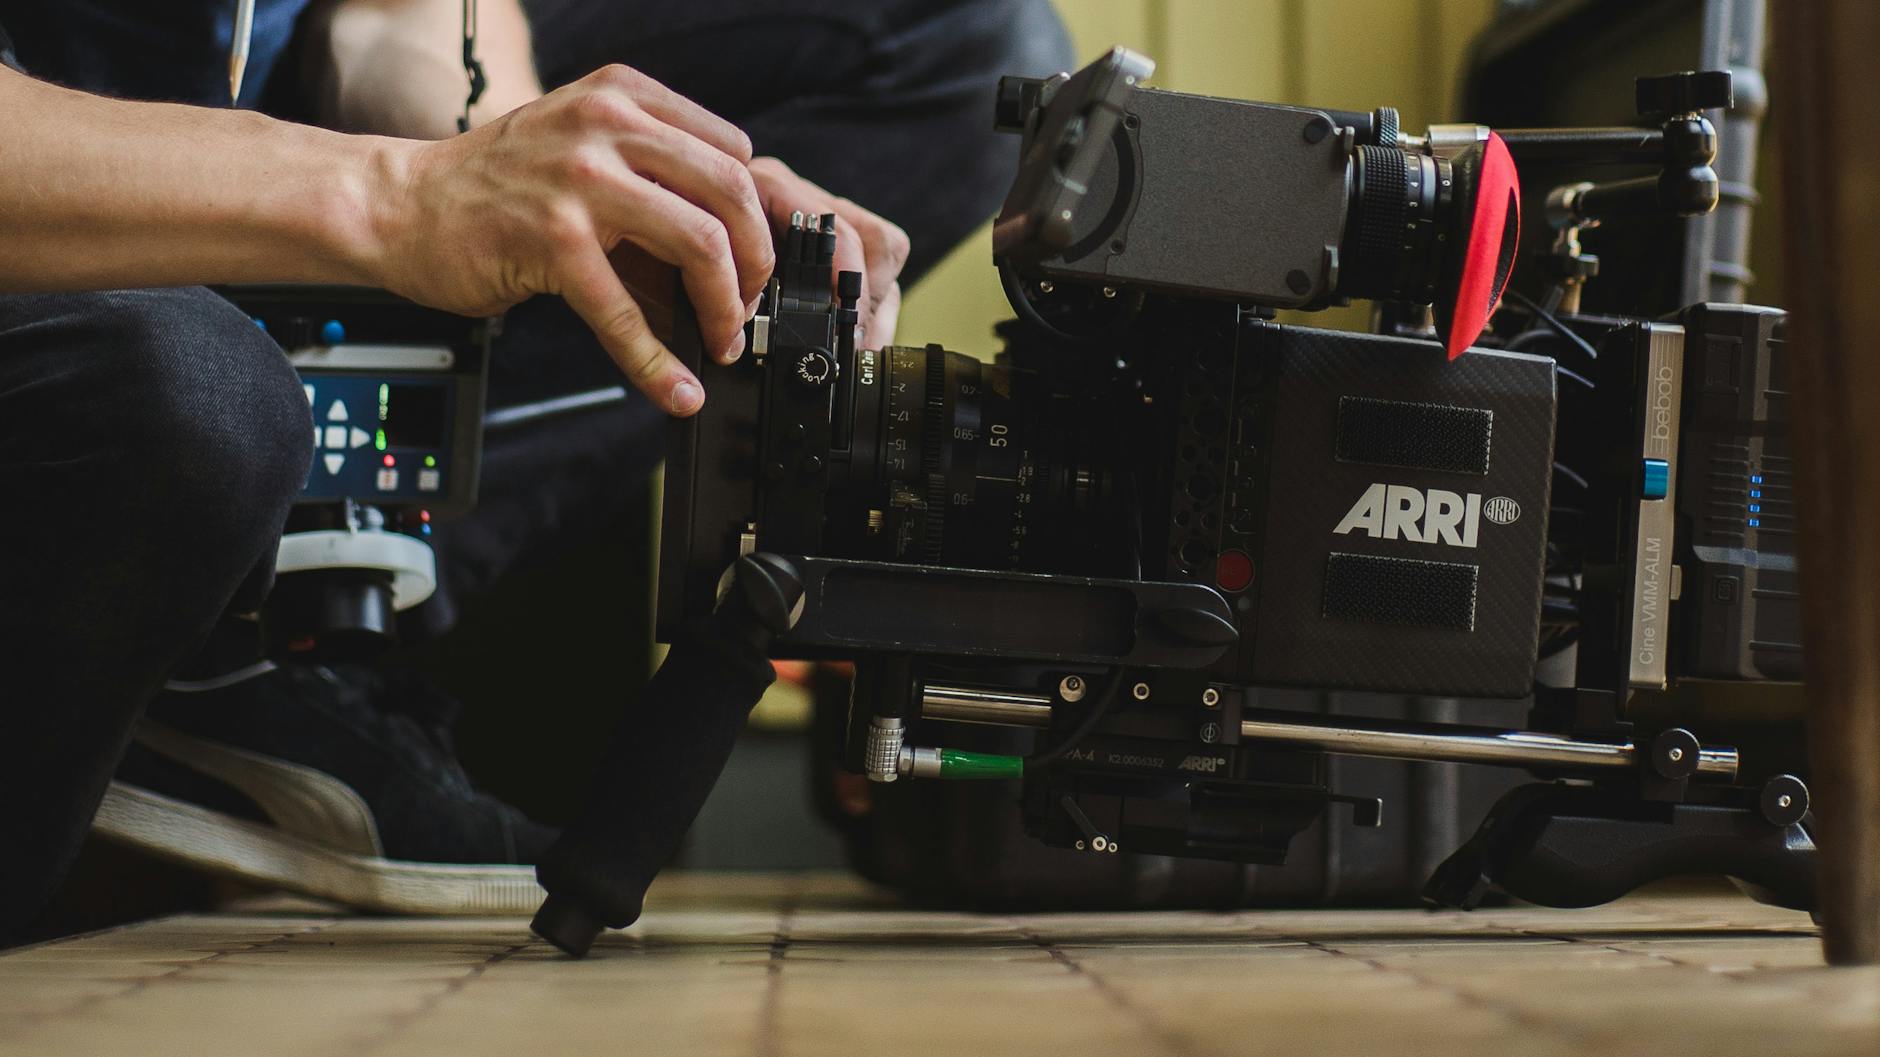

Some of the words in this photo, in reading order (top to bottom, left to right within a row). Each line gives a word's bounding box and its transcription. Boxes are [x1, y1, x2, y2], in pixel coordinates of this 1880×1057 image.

[797, 352, 821, 385] Locking
[860, 365, 874, 385] Carl
[1652, 366, 1674, 440] bebob
[990, 424, 1008, 447] 50
[1332, 482, 1482, 548] ARRI
[1486, 498, 1516, 523] ARRI
[1641, 537, 1662, 622] VMM-ALM
[1639, 627, 1656, 665] Cine
[1177, 754, 1217, 773] ARRI
